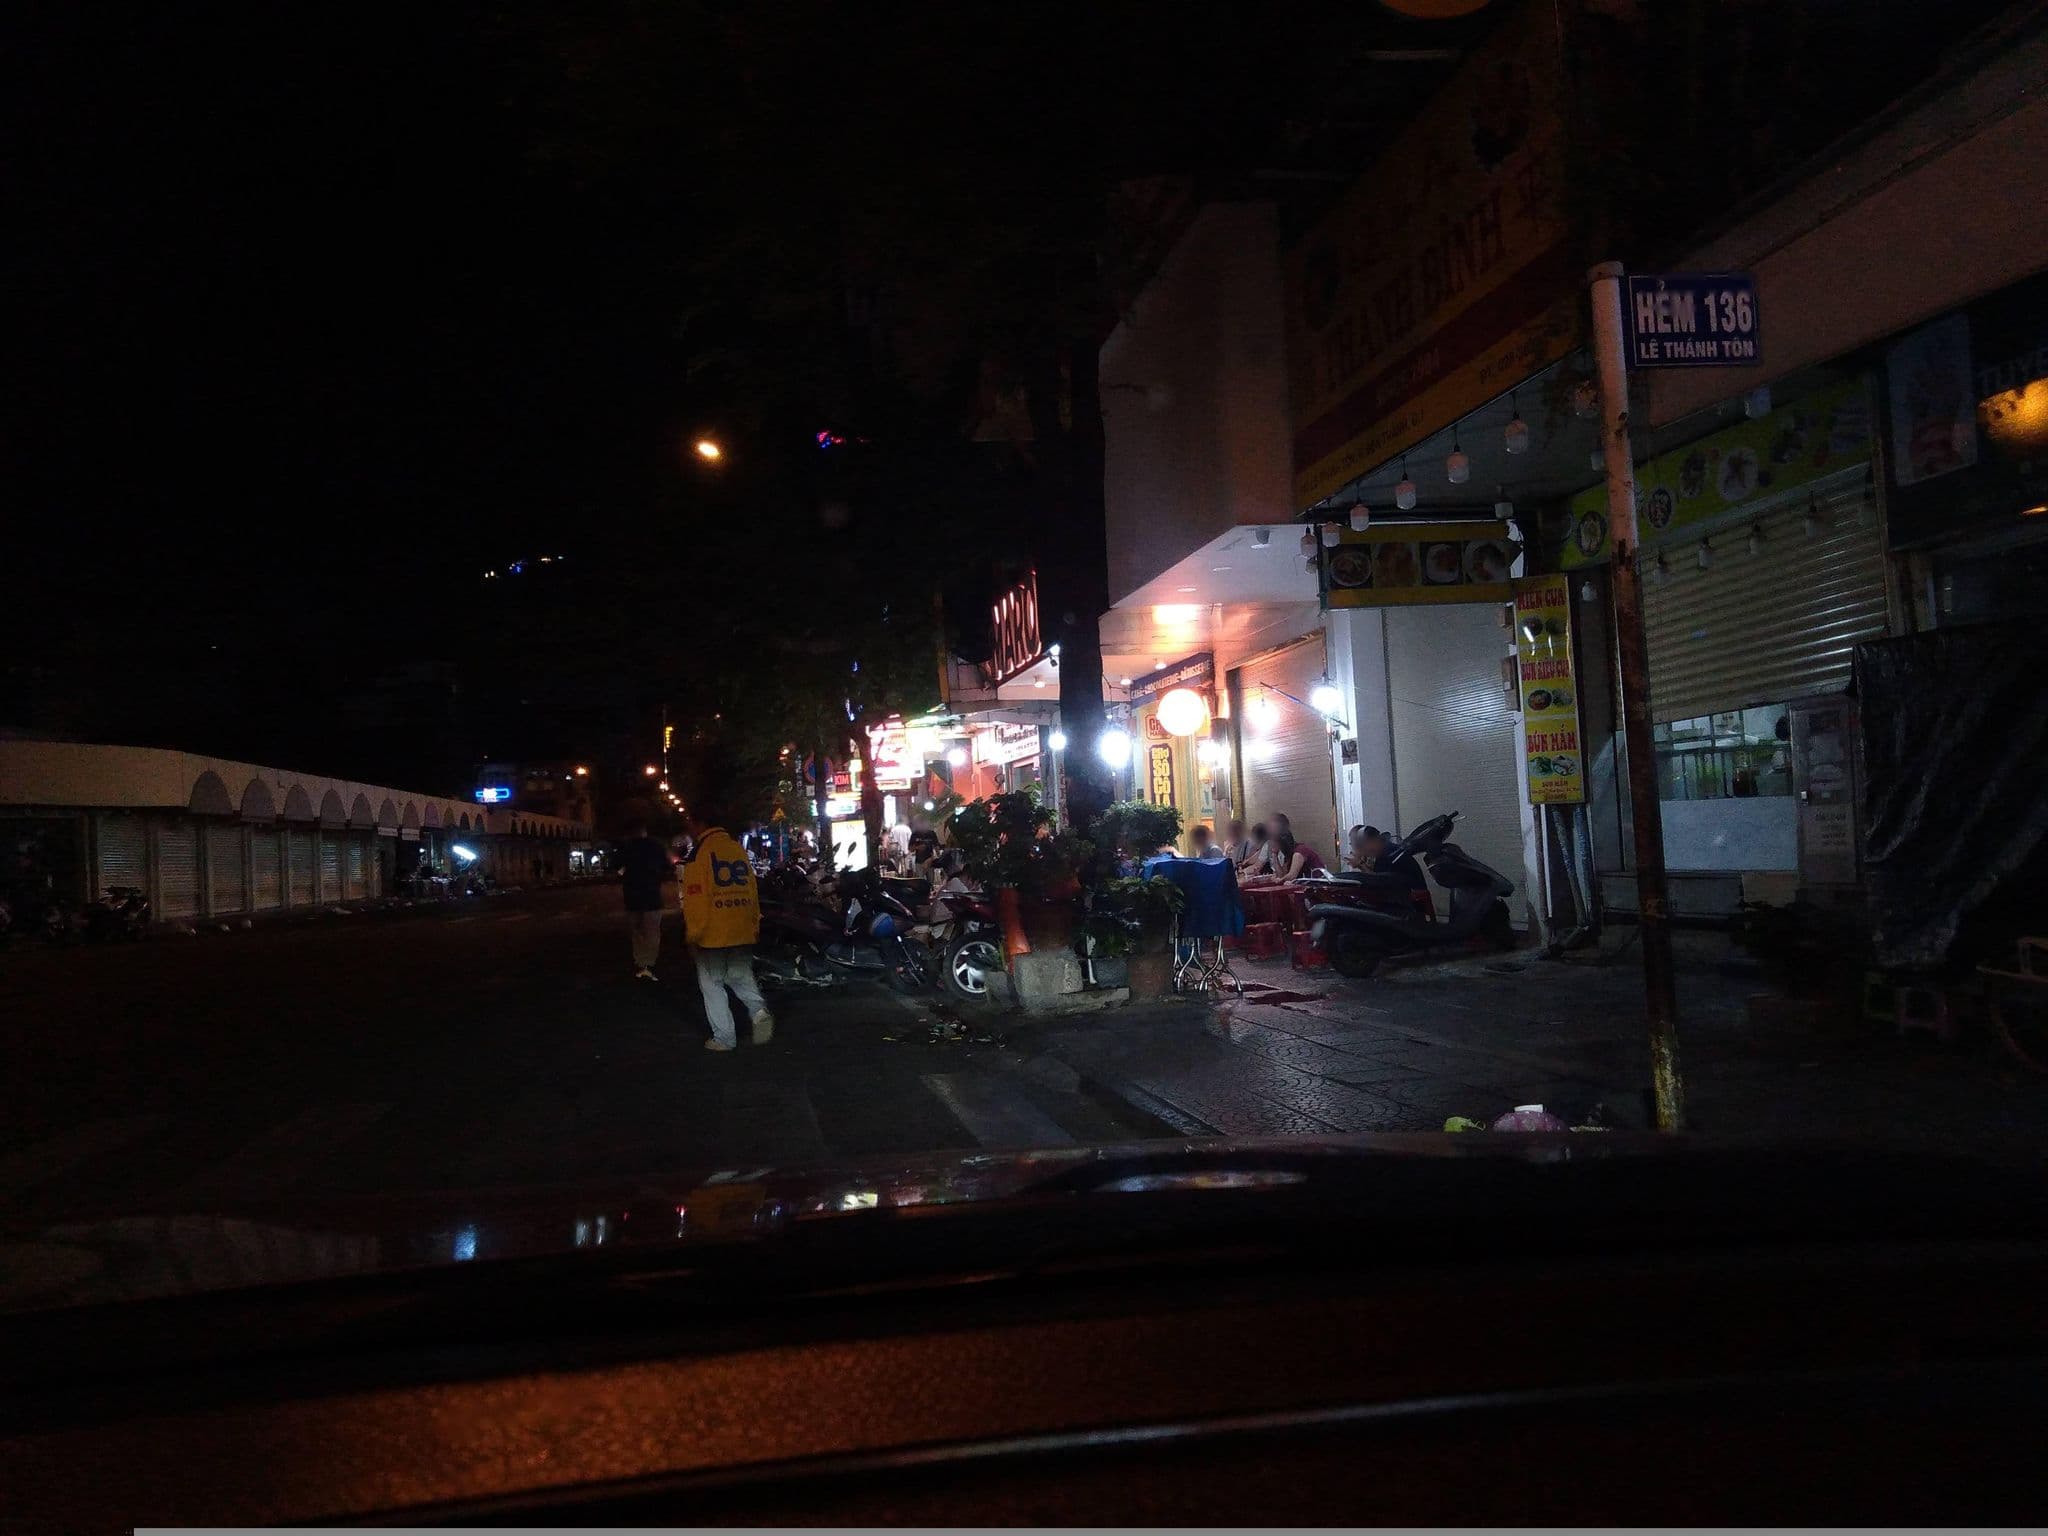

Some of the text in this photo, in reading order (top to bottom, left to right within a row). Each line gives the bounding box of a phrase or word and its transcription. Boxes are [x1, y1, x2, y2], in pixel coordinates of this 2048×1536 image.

[1636, 280, 1752, 333] HẺM 136
[1640, 337, 1754, 359] LÊ THÁNH TÔN
[1527, 730, 1548, 753] BÚN
[710, 851, 748, 887] be
